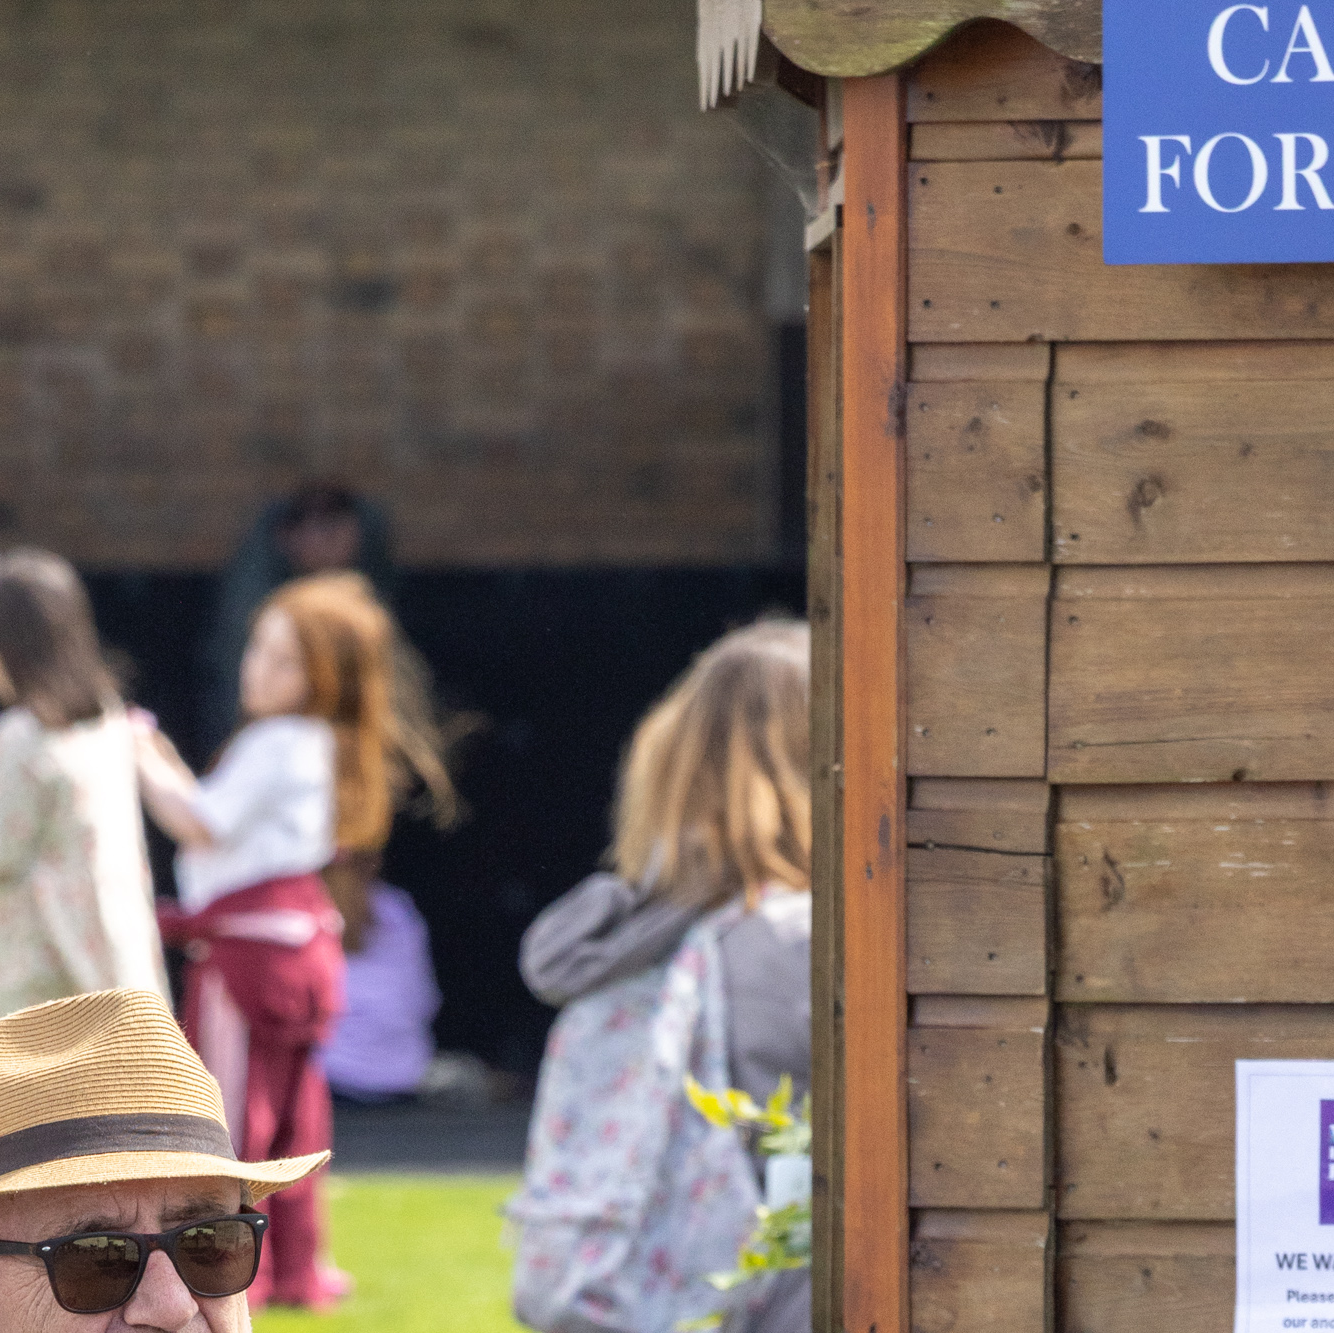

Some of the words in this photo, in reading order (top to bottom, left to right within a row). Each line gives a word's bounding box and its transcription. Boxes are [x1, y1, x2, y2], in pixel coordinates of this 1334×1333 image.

[1207, 3, 1334, 85] CA
[1137, 131, 1334, 213] FOR
[1275, 1252, 1307, 1271] WE
[1312, 1252, 1334, 1271] W
[1287, 1289, 1334, 1303] Please
[1283, 1318, 1307, 1329] our
